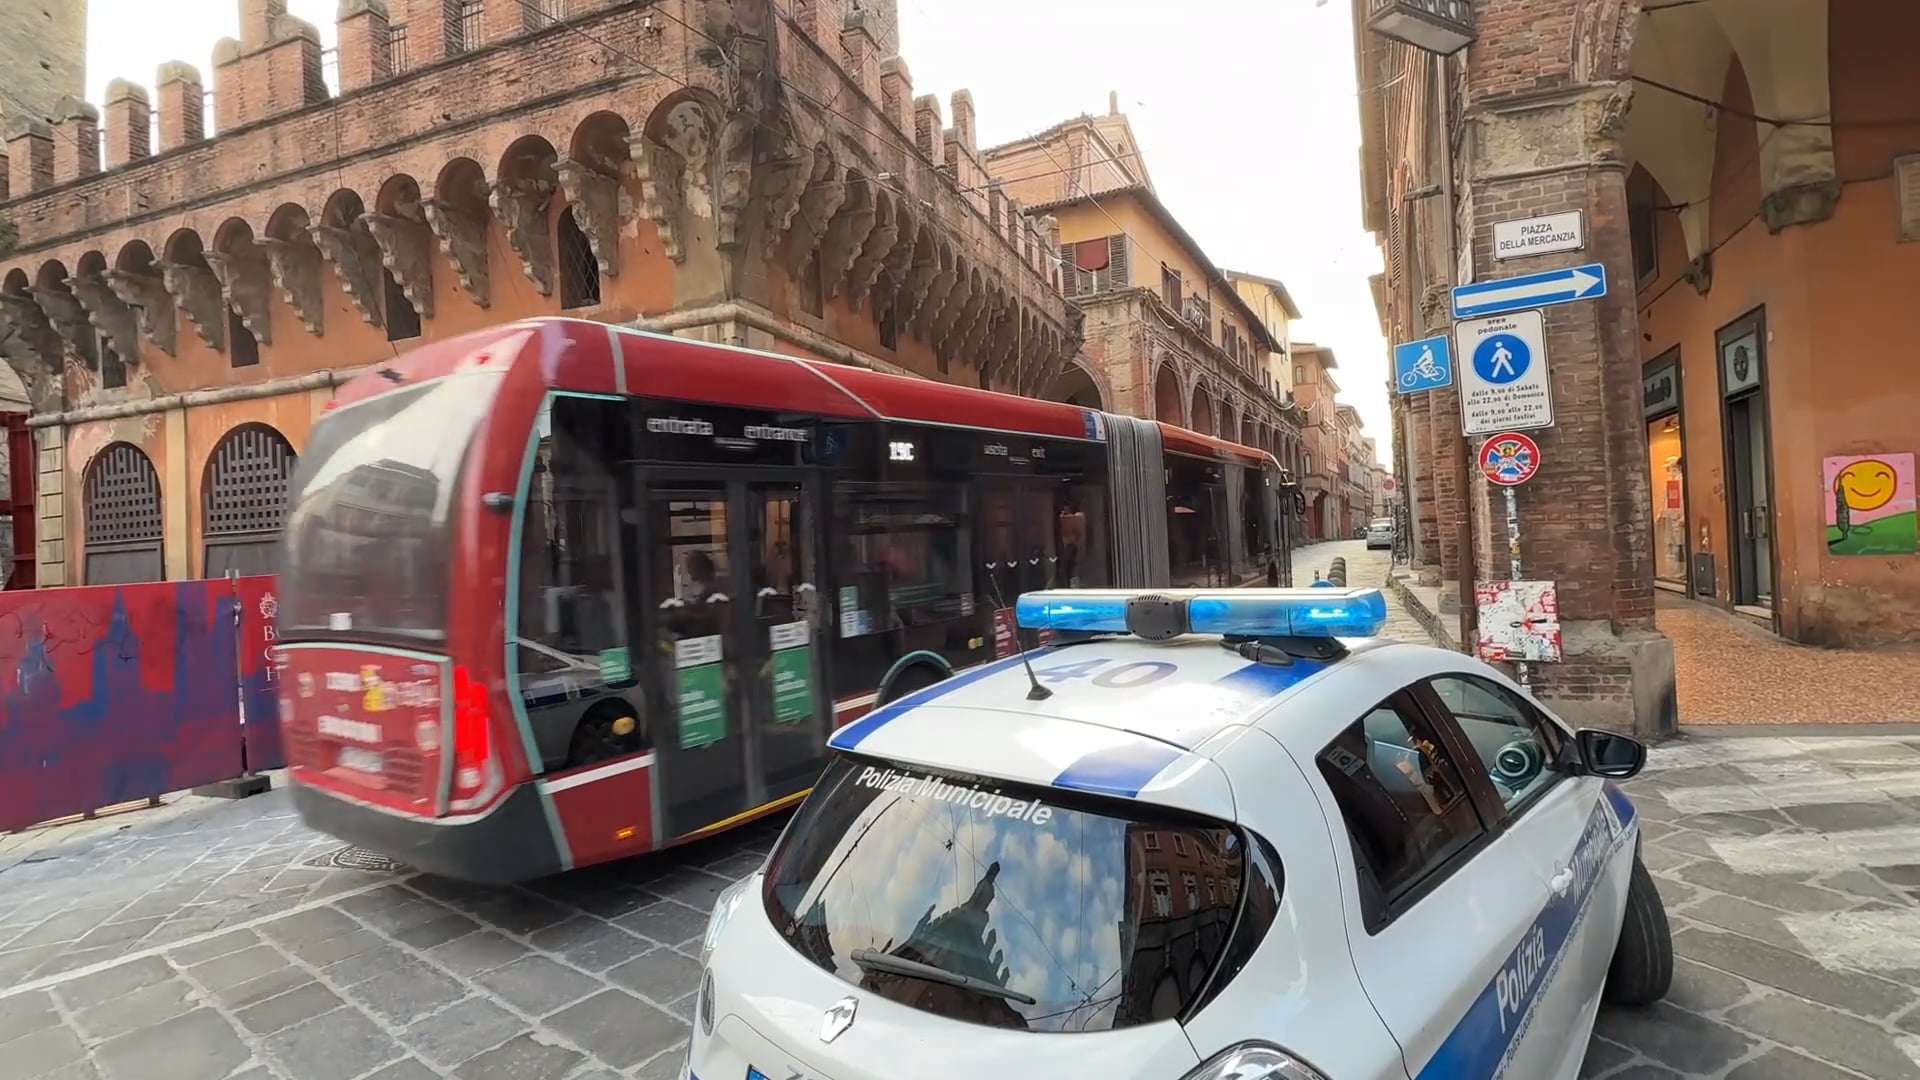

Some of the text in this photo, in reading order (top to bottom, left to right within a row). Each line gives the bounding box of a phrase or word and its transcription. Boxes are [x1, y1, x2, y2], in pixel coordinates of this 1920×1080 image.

[1521, 223, 1553, 235] PIAZZA
[1500, 231, 1576, 250] DELLA MERCANZIA
[1487, 317, 1506, 325] area
[1477, 323, 1517, 335] pedonale
[1471, 389, 1488, 398] dalle
[1516, 383, 1539, 392] Sabato
[1504, 394, 1511, 402] di
[1512, 391, 1544, 400] Domenica
[1471, 410, 1488, 418] dalle
[1508, 406, 1521, 414] alle
[1480, 417, 1491, 425] dei
[1492, 415, 1512, 424] giorni
[1513, 413, 1536, 421] festivi
[1025, 658, 1179, 688] 40
[855, 766, 1052, 825] Polizia Municipale
[1496, 924, 1546, 1035] Polizia
